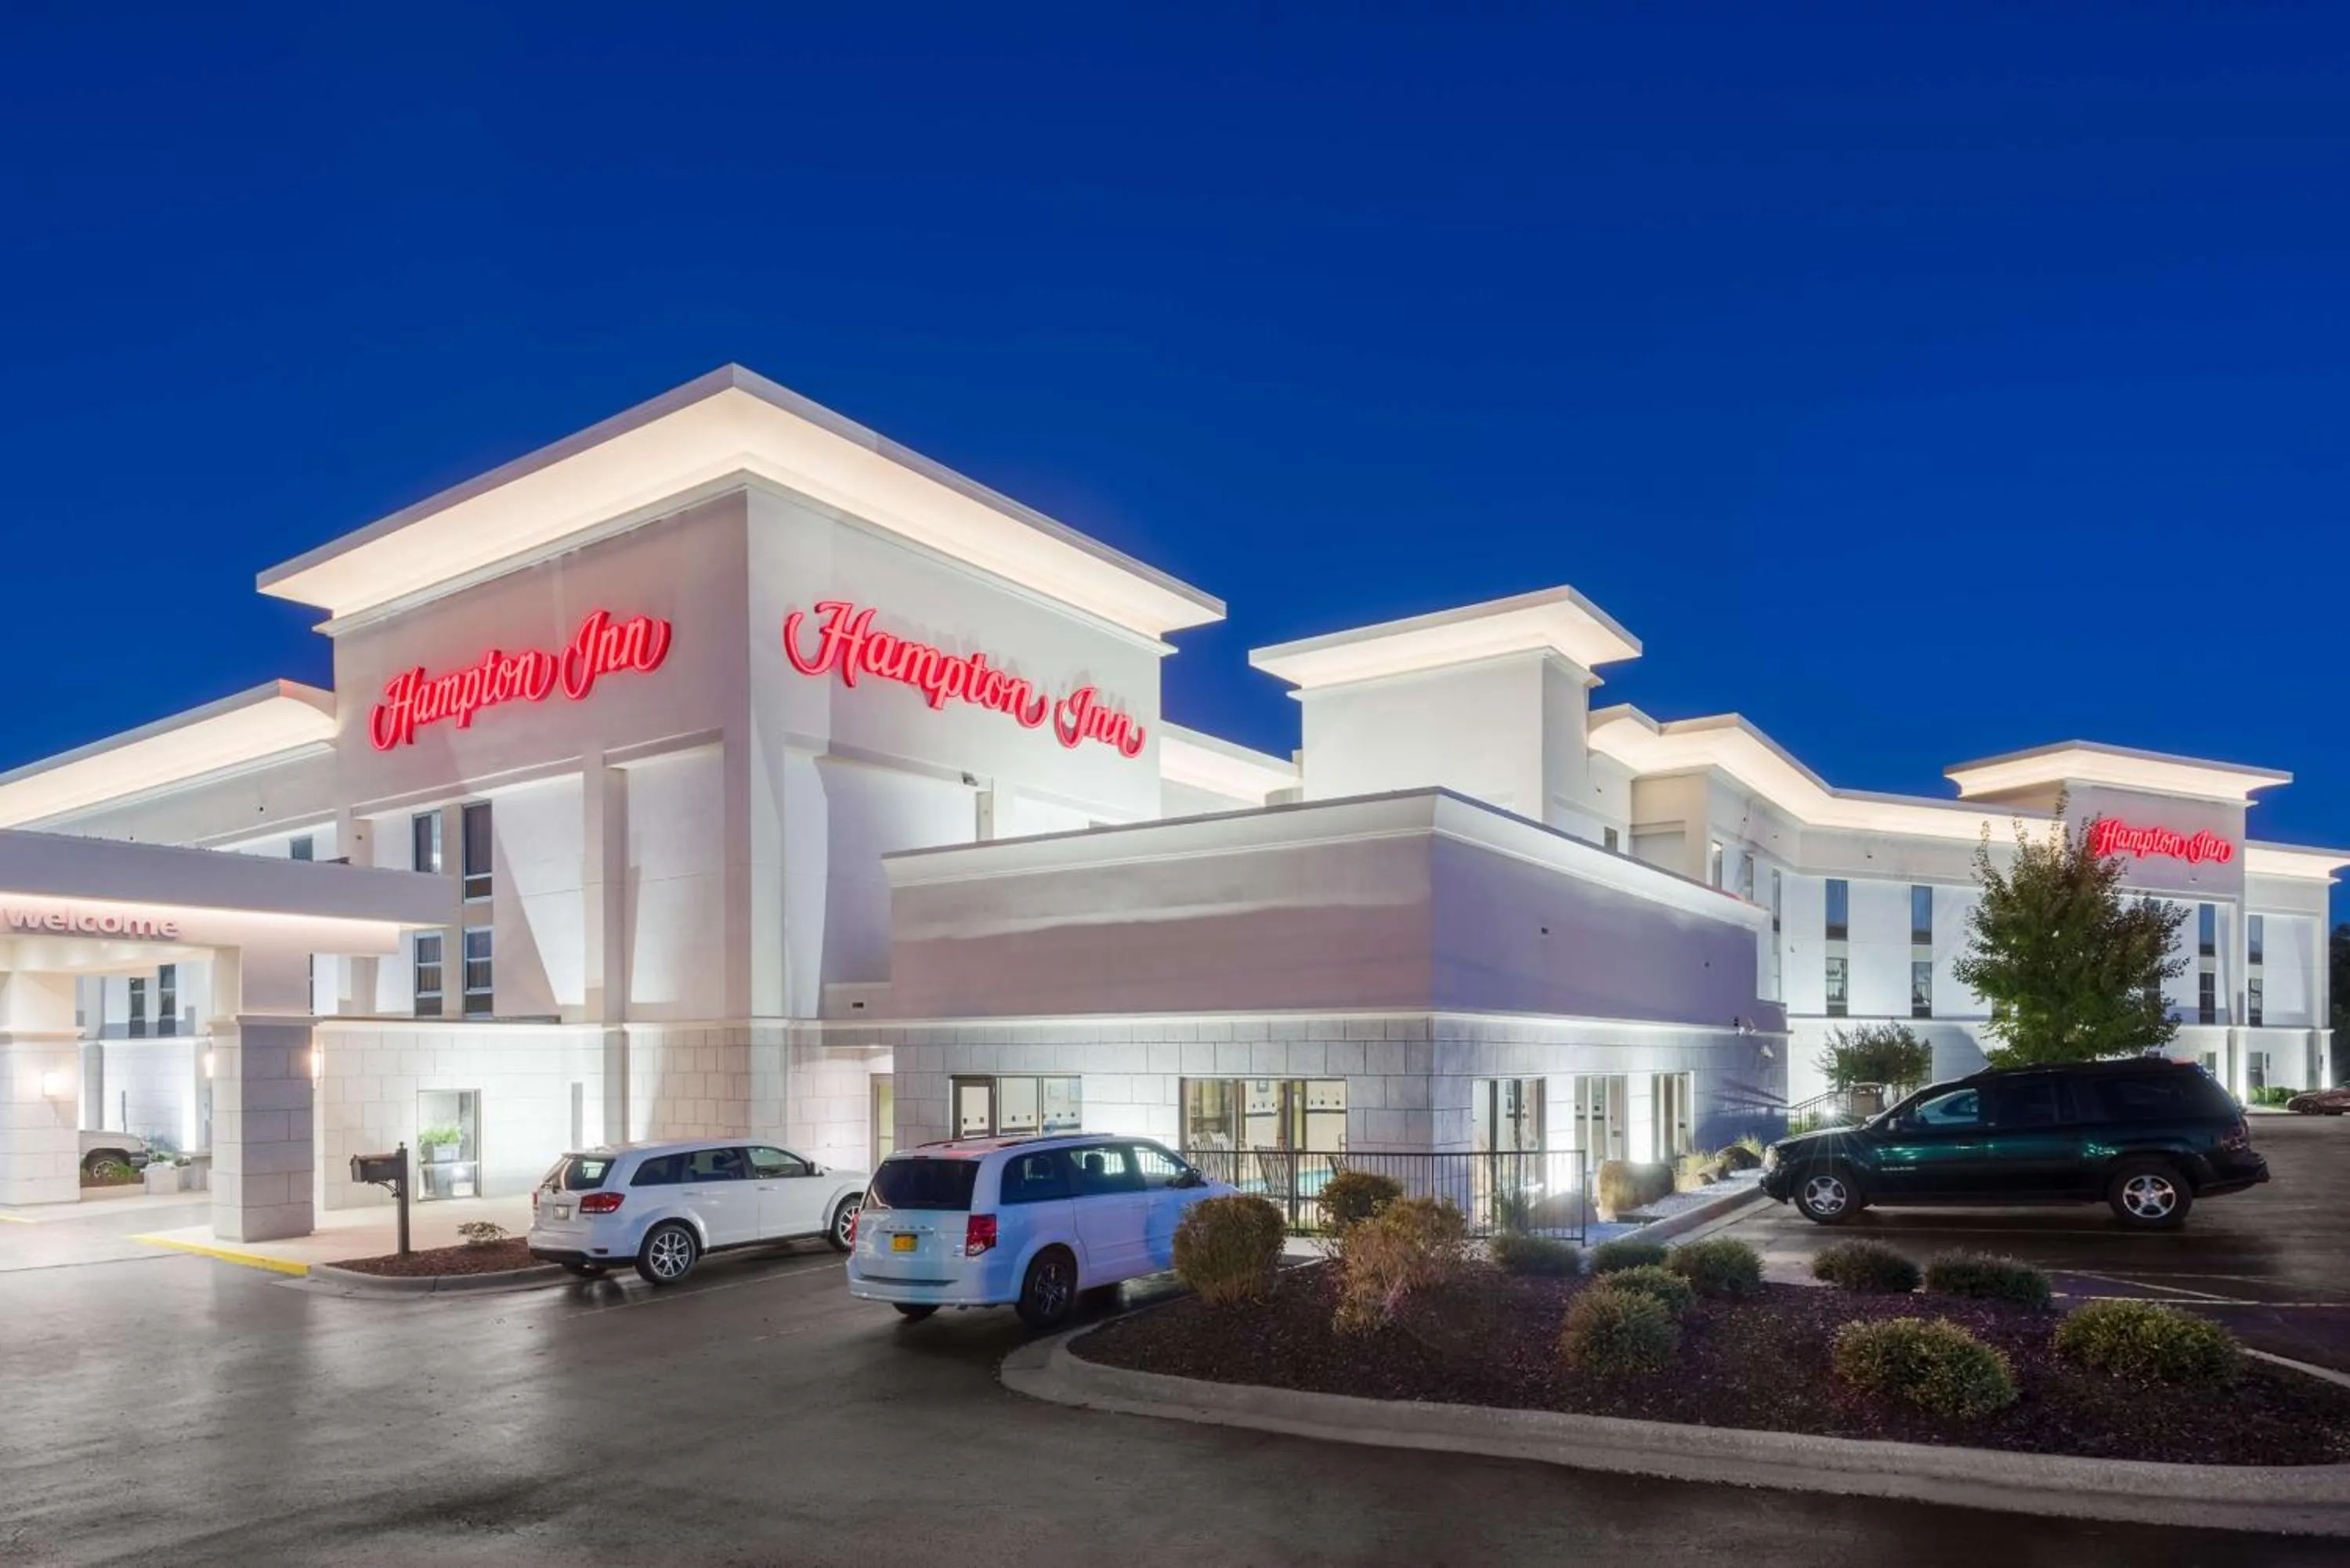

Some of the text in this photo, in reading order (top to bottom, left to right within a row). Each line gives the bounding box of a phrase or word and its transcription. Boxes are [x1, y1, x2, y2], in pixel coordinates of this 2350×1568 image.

[371, 610, 672, 750] Hampton Inn
[784, 601, 1146, 758] Hampton Inn
[2092, 819, 2233, 863] Hampton Inn
[3, 906, 180, 938] welcome
